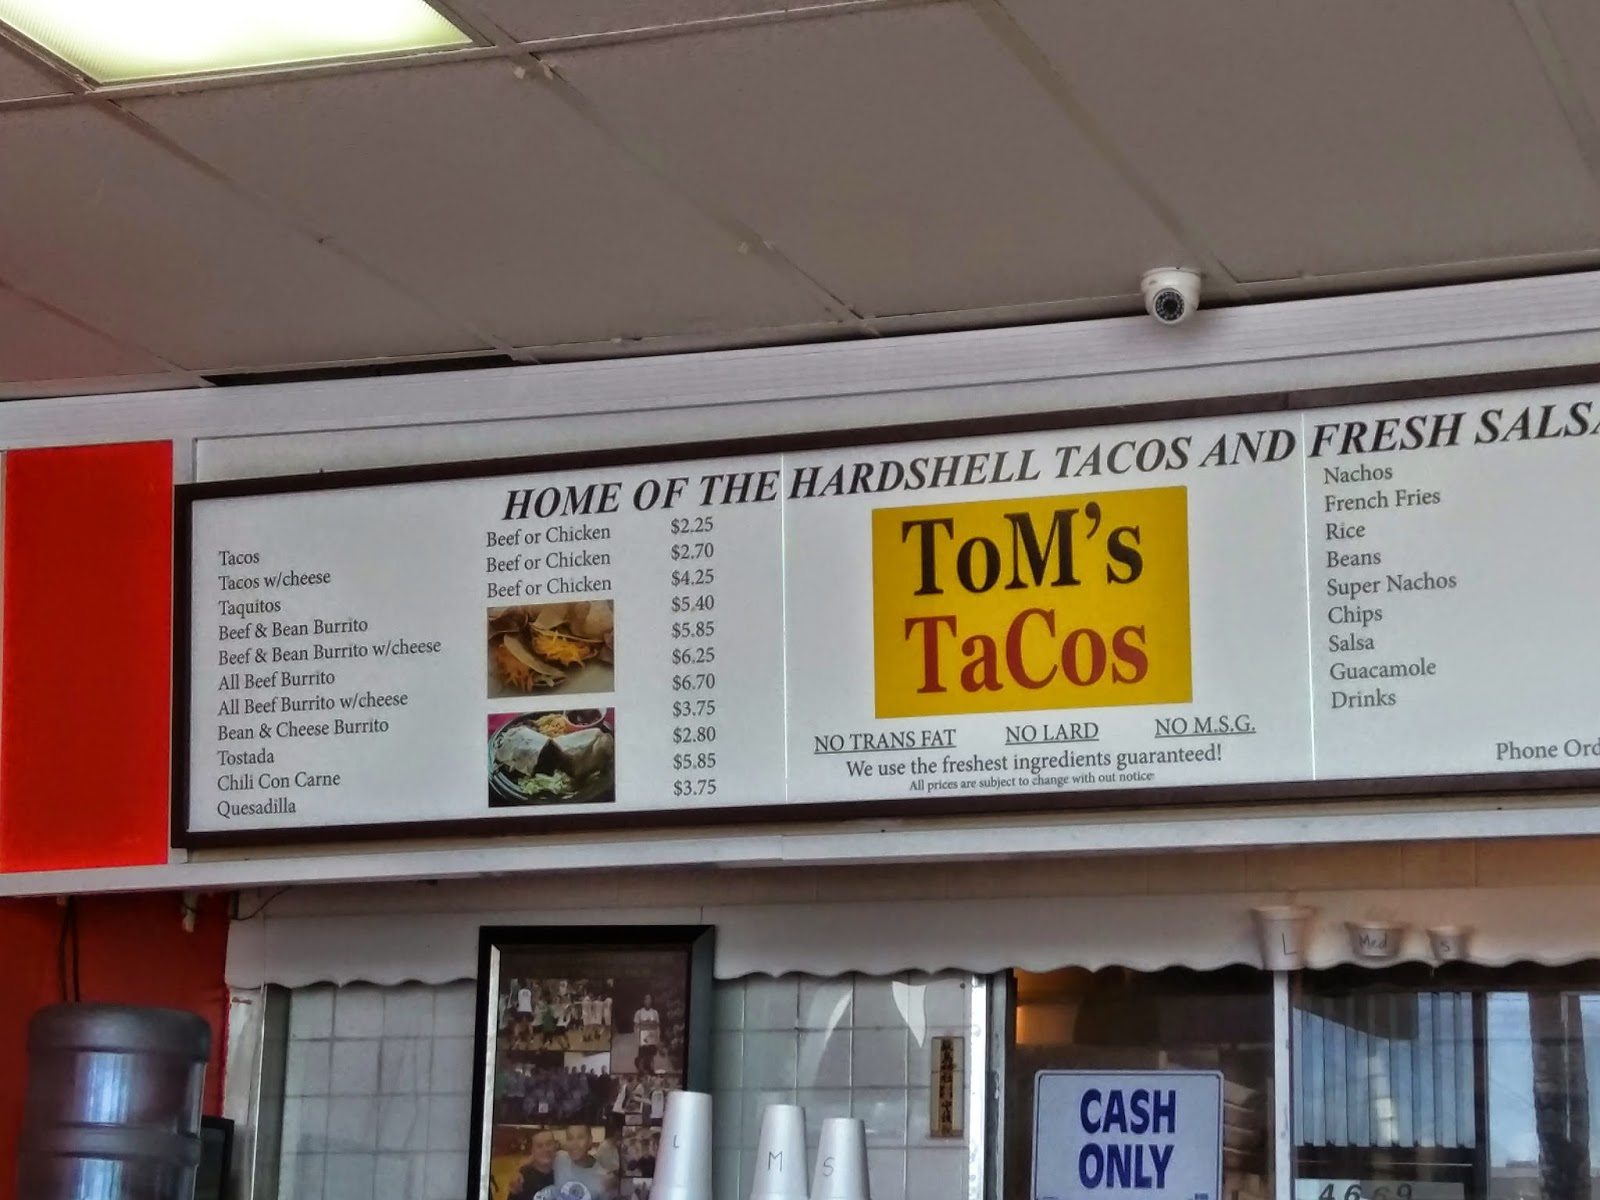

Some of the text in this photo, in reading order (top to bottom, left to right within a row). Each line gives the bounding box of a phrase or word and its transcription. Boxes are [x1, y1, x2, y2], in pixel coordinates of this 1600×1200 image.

[502, 482, 622, 520] HOME
[633, 477, 689, 511] OF
[700, 470, 780, 506] THE
[787, 448, 1040, 500] HARDSHELL
[1055, 436, 1192, 478] TACOS
[1198, 429, 1296, 467] AND
[1308, 412, 1466, 458] FRESH
[1323, 463, 1392, 484] Nachos
[1325, 489, 1440, 512] French Fries
[486, 524, 610, 547] Beef or Chicken
[671, 516, 713, 535] $2.25
[1326, 523, 1365, 540] Rice
[219, 551, 259, 566] Tacos
[671, 542, 714, 561] $2.70
[901, 502, 1143, 596] ToM's
[1326, 551, 1381, 568] Beans
[486, 550, 610, 572] Beef or Chicken
[218, 570, 330, 590] Tacos w/cheese
[487, 576, 611, 598] Beef or Chicken
[671, 569, 714, 587] $4.25
[1327, 572, 1457, 600] Super Nachos
[218, 599, 281, 619] Taquitos
[672, 595, 714, 613] $5.40
[1328, 605, 1382, 627] Chips
[219, 619, 368, 640] Beef & Bean Burrito
[671, 621, 714, 639] $5.85
[219, 639, 441, 665] Beef & Bean Burrito w/cheese
[904, 608, 1148, 694] TaCos
[1329, 633, 1375, 652] Salsa
[672, 647, 715, 665] $6.25
[1330, 657, 1436, 680] Guacamole
[218, 671, 335, 690] All Beef Burrito
[673, 673, 715, 691] $6.70
[218, 691, 408, 716] All Beef Burrito w/cheese
[673, 700, 715, 718] $3.75
[1332, 688, 1396, 709] Drinks
[218, 718, 389, 740] Bean & Cheese Burrito
[673, 726, 716, 744] $2.80
[1005, 722, 1099, 745] NO LARD
[1155, 715, 1257, 737] NO M.S.G.
[814, 729, 957, 754] NO TRANS FAT
[1496, 740, 1558, 760] Phone
[217, 748, 275, 766] Tostada
[673, 753, 716, 771] $5.85
[846, 743, 1221, 777] We use the freshest ingredients guaranteed!
[217, 772, 340, 791] Chili Con Carne
[674, 779, 716, 797] $3.75
[910, 771, 1154, 793] All prices are subject to change with out notice
[217, 797, 296, 819] Quesadilla
[1080, 1088, 1176, 1134] CASH
[1078, 1142, 1175, 1189] ONLY
